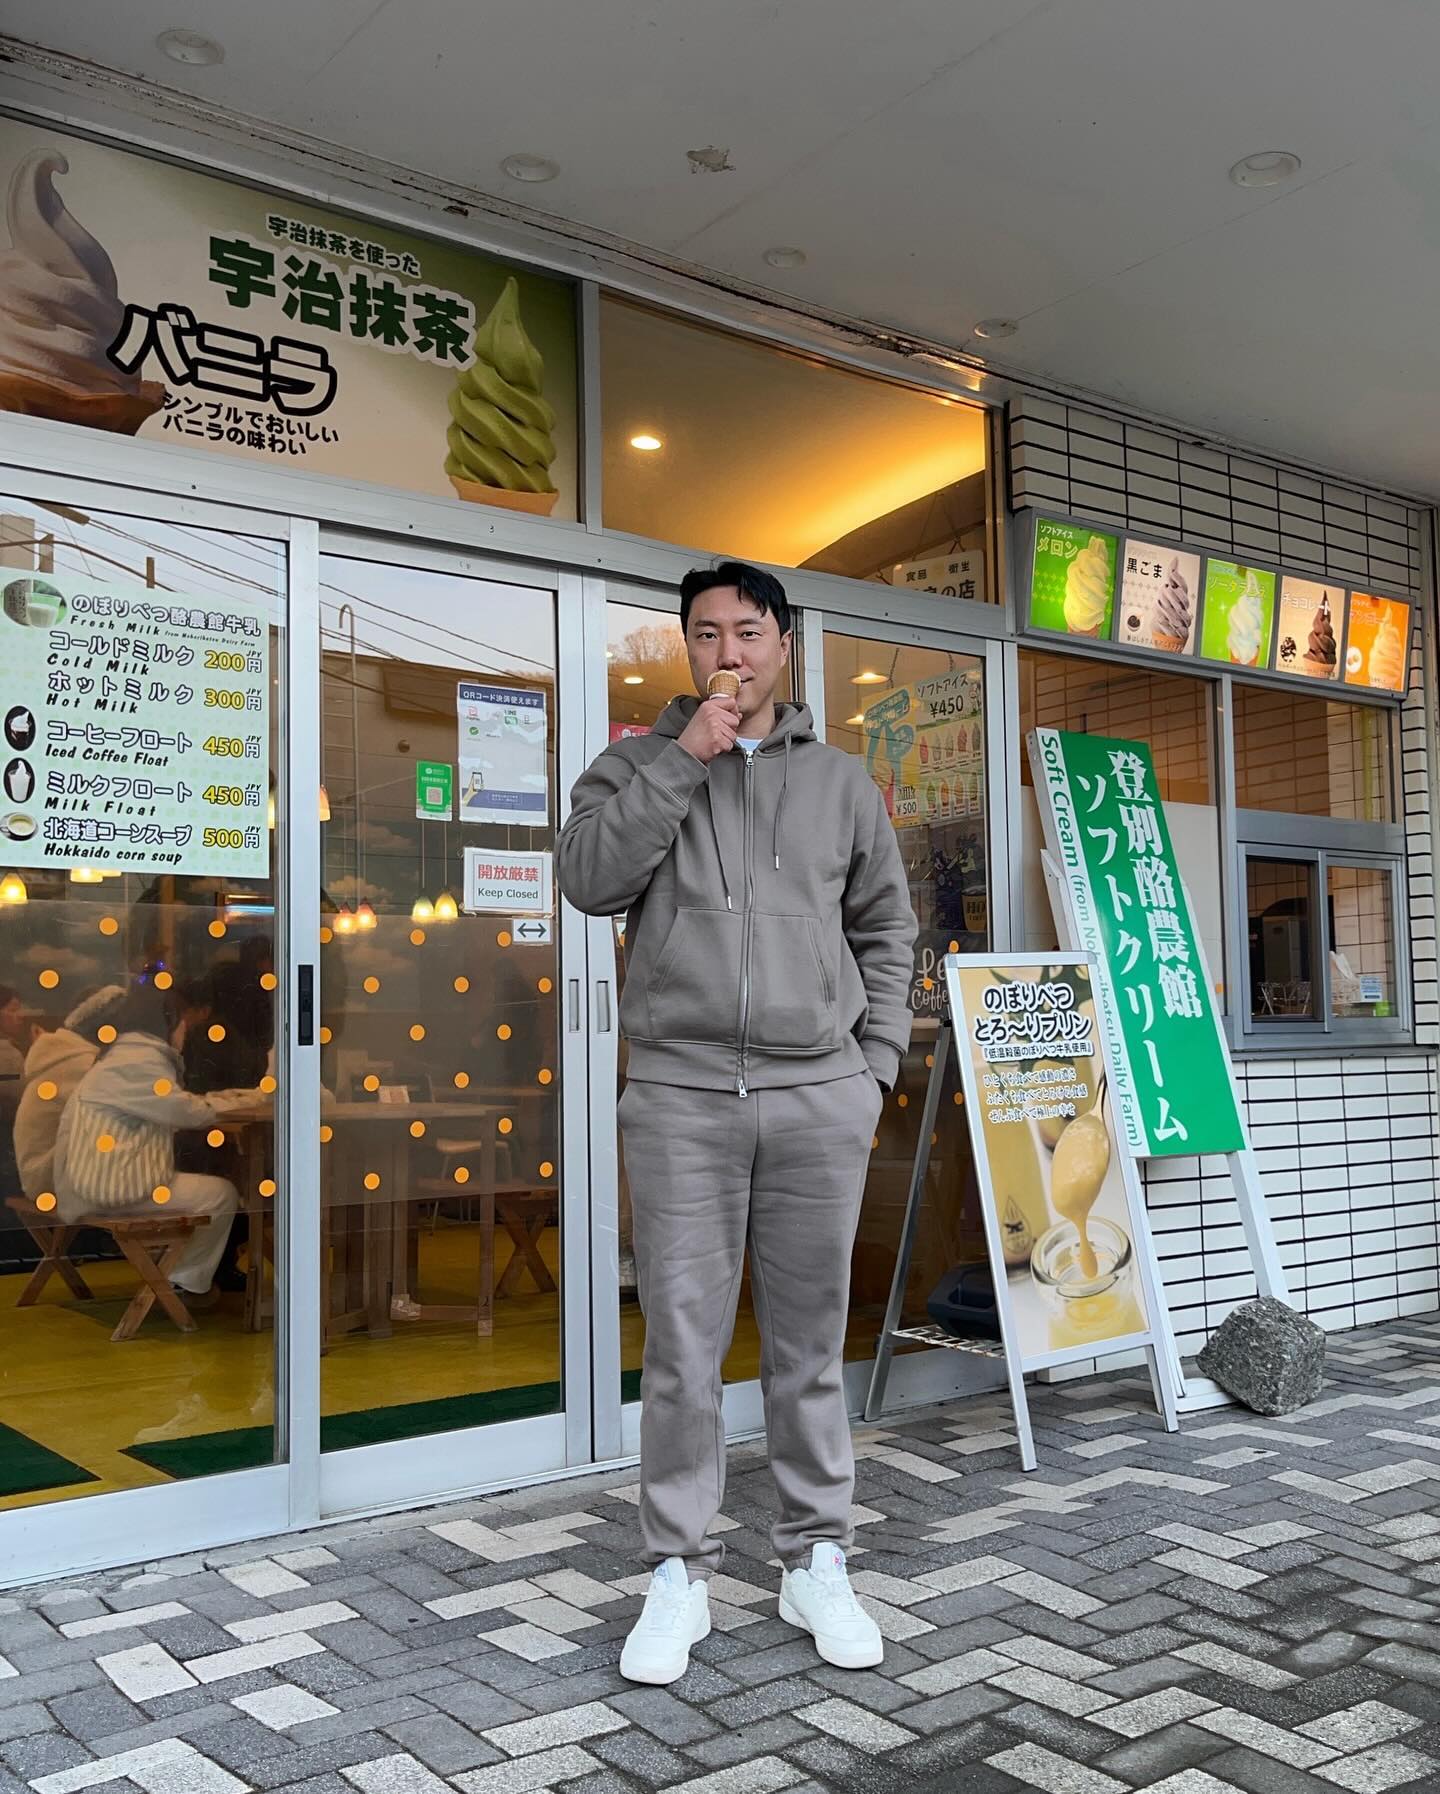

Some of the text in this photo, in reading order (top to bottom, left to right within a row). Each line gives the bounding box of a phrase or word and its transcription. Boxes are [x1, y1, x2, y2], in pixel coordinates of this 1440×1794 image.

[268, 216, 420, 276] 宇治抹茶を使った
[209, 236, 471, 364] 宇治抹茶
[107, 303, 338, 416] バニラ
[165, 393, 339, 444] シンプルでおいしい
[163, 414, 307, 455] バニラの味わい
[1037, 537, 1078, 559] メロン
[1127, 557, 1162, 578] 黒ごま
[1281, 592, 1331, 615] チョコレート
[71, 615, 115, 630] Fresh
[126, 623, 160, 635] Milk
[49, 631, 194, 667] コールドミルク
[246, 650, 262, 658] JPY
[47, 653, 149, 675] Cold Milk
[48, 671, 193, 705] ホットミルク
[246, 688, 262, 696] JPY
[918, 673, 969, 697] ソフトアイス
[46, 693, 138, 713] Hot Milk
[463, 691, 539, 706] QRコード決済使えます
[930, 695, 964, 718] ¥450
[47, 720, 192, 754] コーヒーフロート
[245, 735, 262, 743] JPY
[46, 744, 169, 767] Iced Coffee Float
[1042, 735, 1065, 784] Soft
[47, 771, 192, 803] ミルクフロート
[245, 783, 262, 791] JPY
[44, 797, 156, 816] Milk Float
[44, 817, 192, 846] 北海道コーンスープ
[1053, 791, 1079, 867] Cream
[44, 843, 183, 865] Hokkaido corn soup
[478, 864, 539, 882] 開放厳禁
[1107, 750, 1203, 1018] 登別酪農館
[478, 888, 538, 900] Keep Closed
[1070, 875, 1089, 921] (from
[1076, 774, 1188, 1142] ソフトクリーム
[984, 984, 1073, 1010] のぼりべつ
[1120, 1093, 1142, 1147] Farm)
